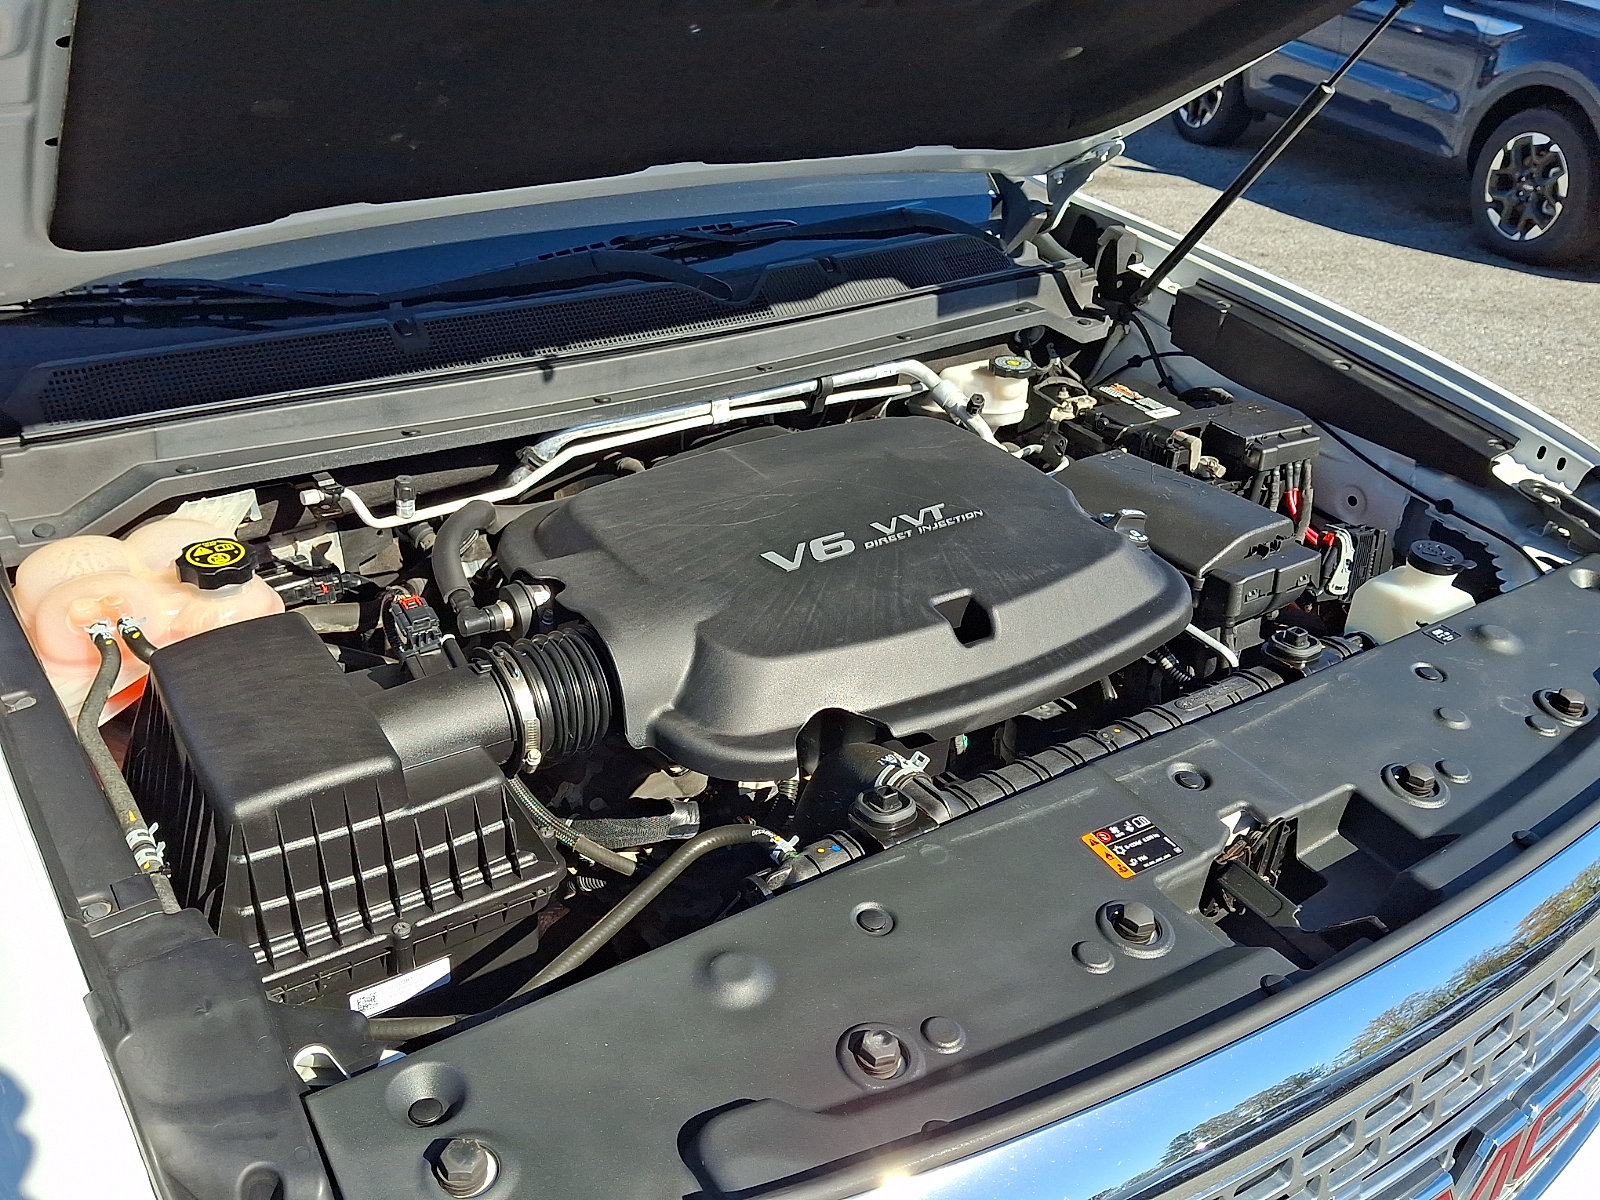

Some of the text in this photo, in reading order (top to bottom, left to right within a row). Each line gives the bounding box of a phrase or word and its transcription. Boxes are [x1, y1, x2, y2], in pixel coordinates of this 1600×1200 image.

[760, 503, 945, 572] V6 VVT
[864, 510, 984, 550] DIRECT INJECTION
